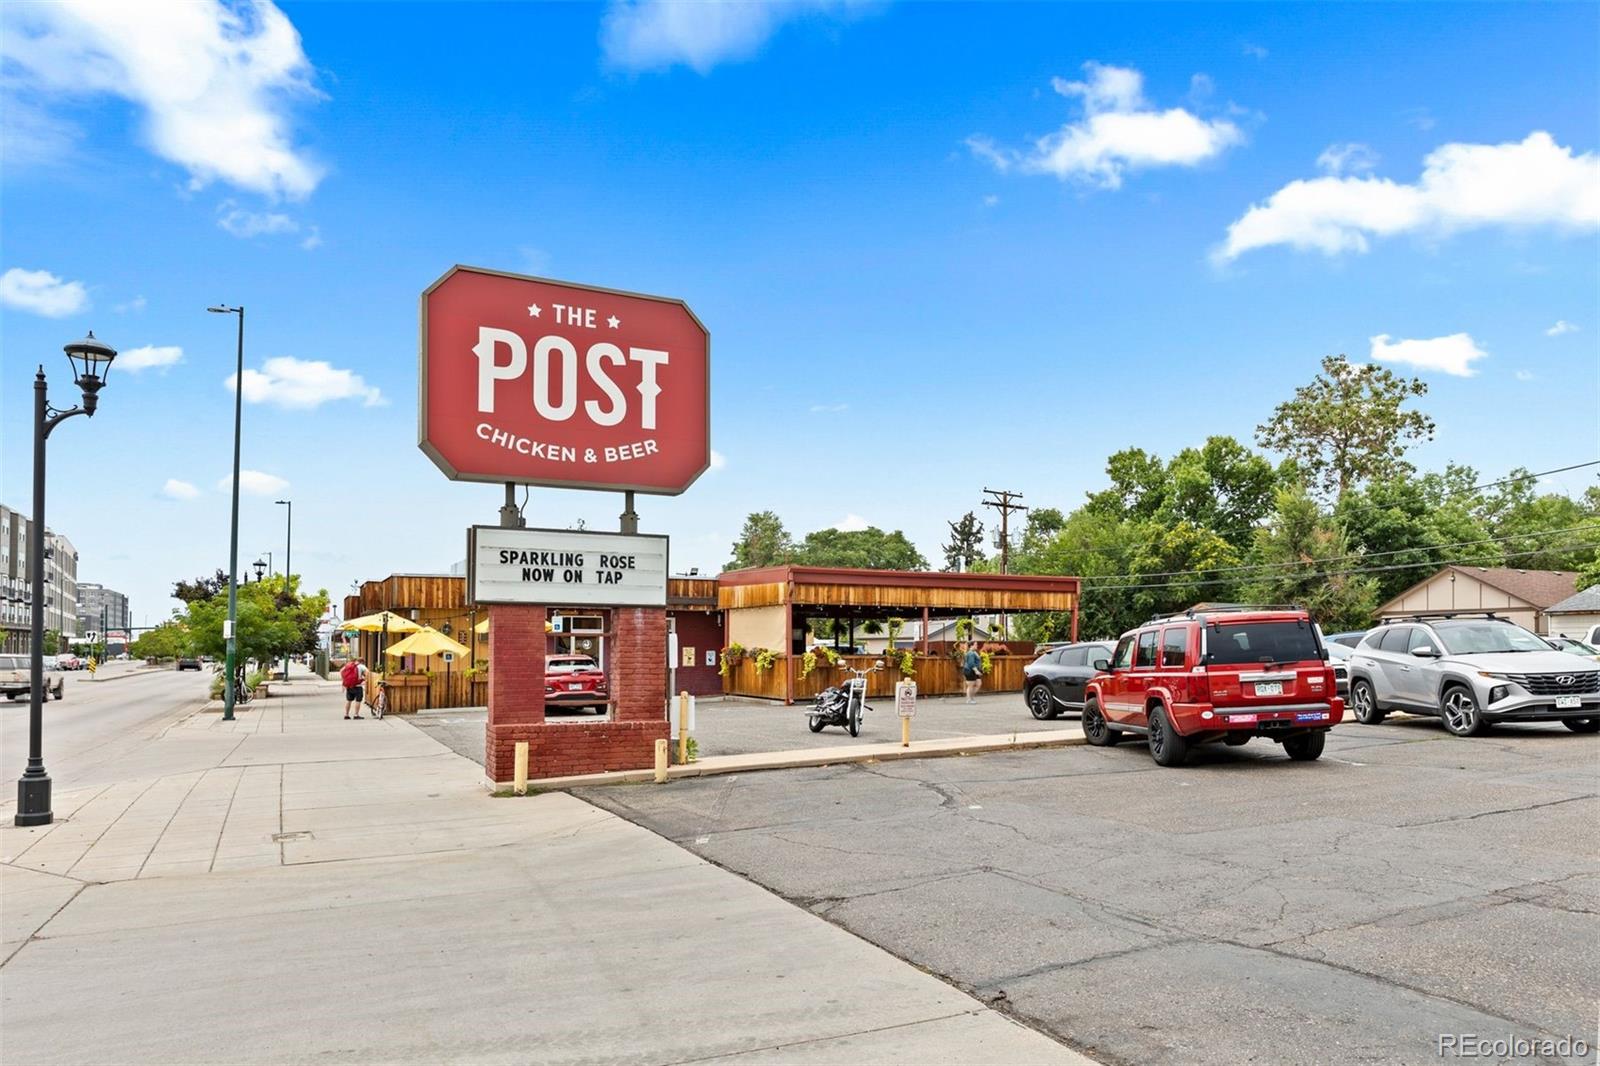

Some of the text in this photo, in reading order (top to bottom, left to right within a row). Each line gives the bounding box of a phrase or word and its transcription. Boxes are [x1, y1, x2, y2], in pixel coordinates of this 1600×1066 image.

[552, 303, 597, 329] THE
[471, 326, 669, 430] POST
[476, 422, 659, 464] CHICKEN & BEER
[500, 550, 635, 569] SPARKLING ROSE
[522, 567, 623, 585] NOW ON TAP
